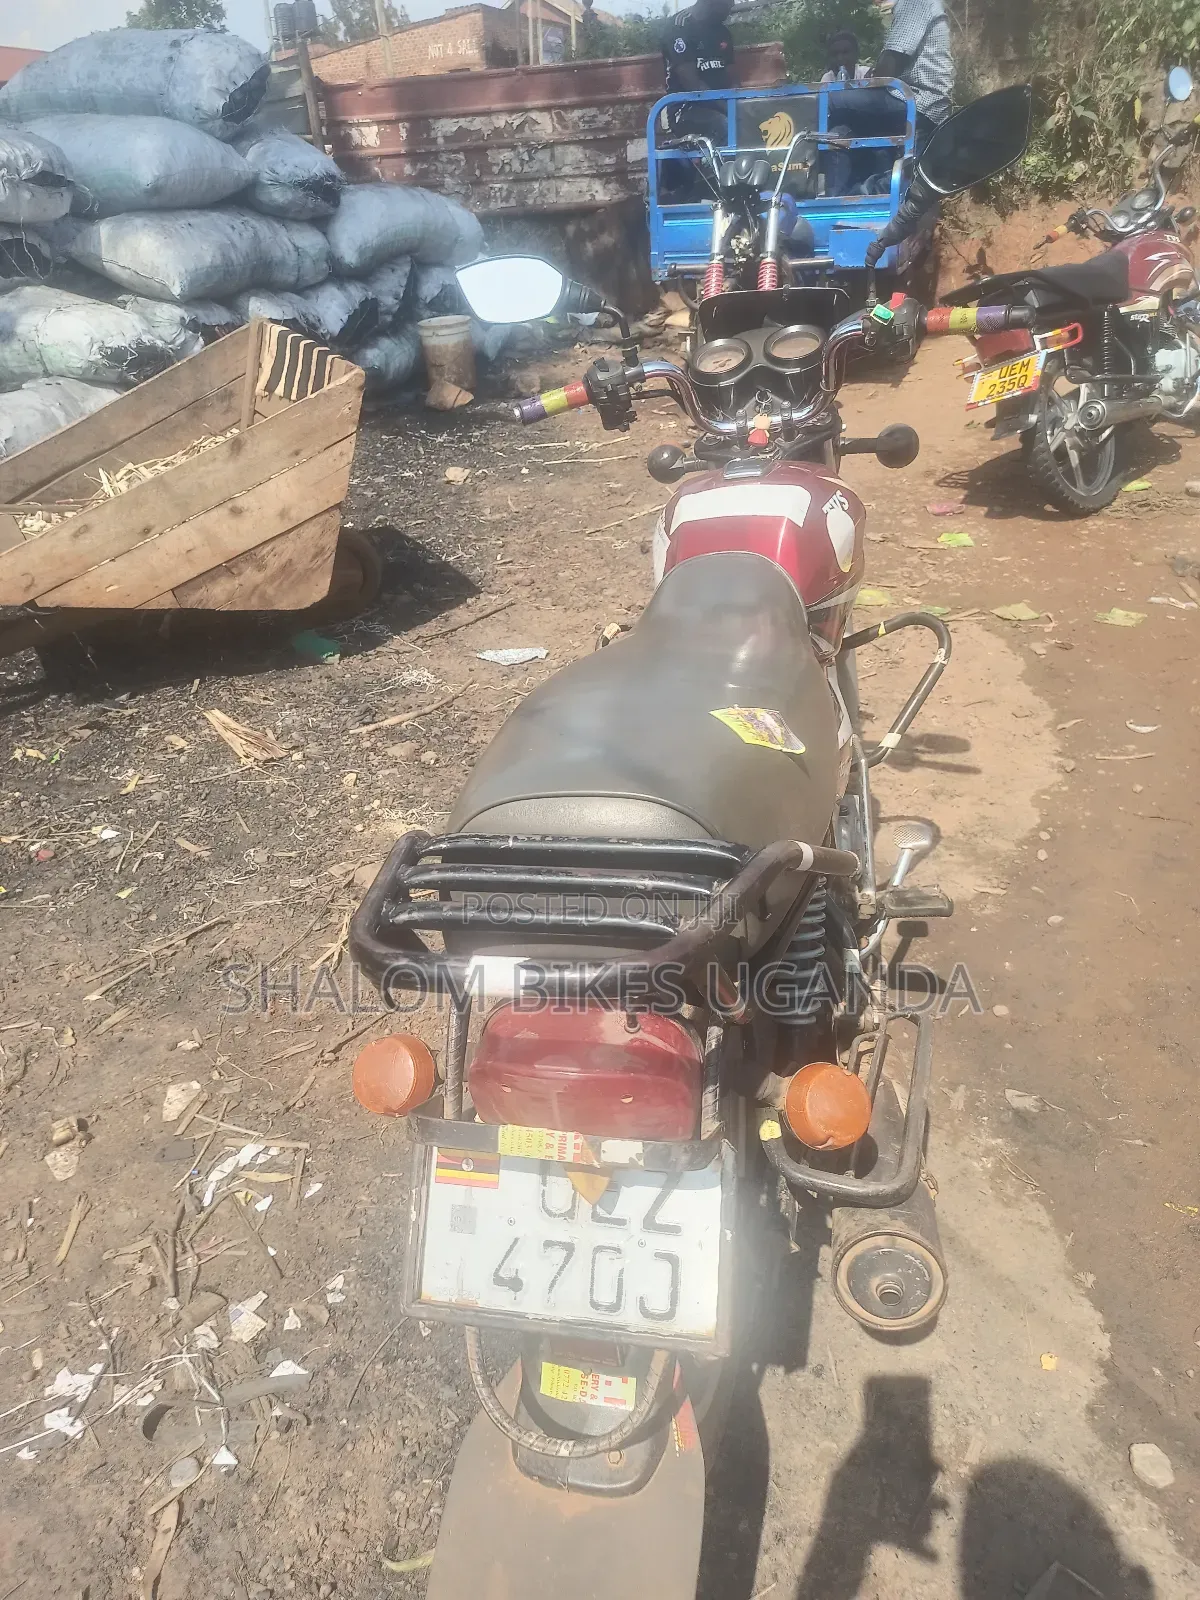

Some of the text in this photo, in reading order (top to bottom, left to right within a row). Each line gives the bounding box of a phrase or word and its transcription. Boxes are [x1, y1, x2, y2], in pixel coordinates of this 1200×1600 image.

[429, 44, 443, 59] NOT
[448, 42, 453, 56] 4
[998, 358, 1031, 379] UEM
[986, 375, 1028, 397] 235Q
[591, 1373, 600, 1391] ERY
